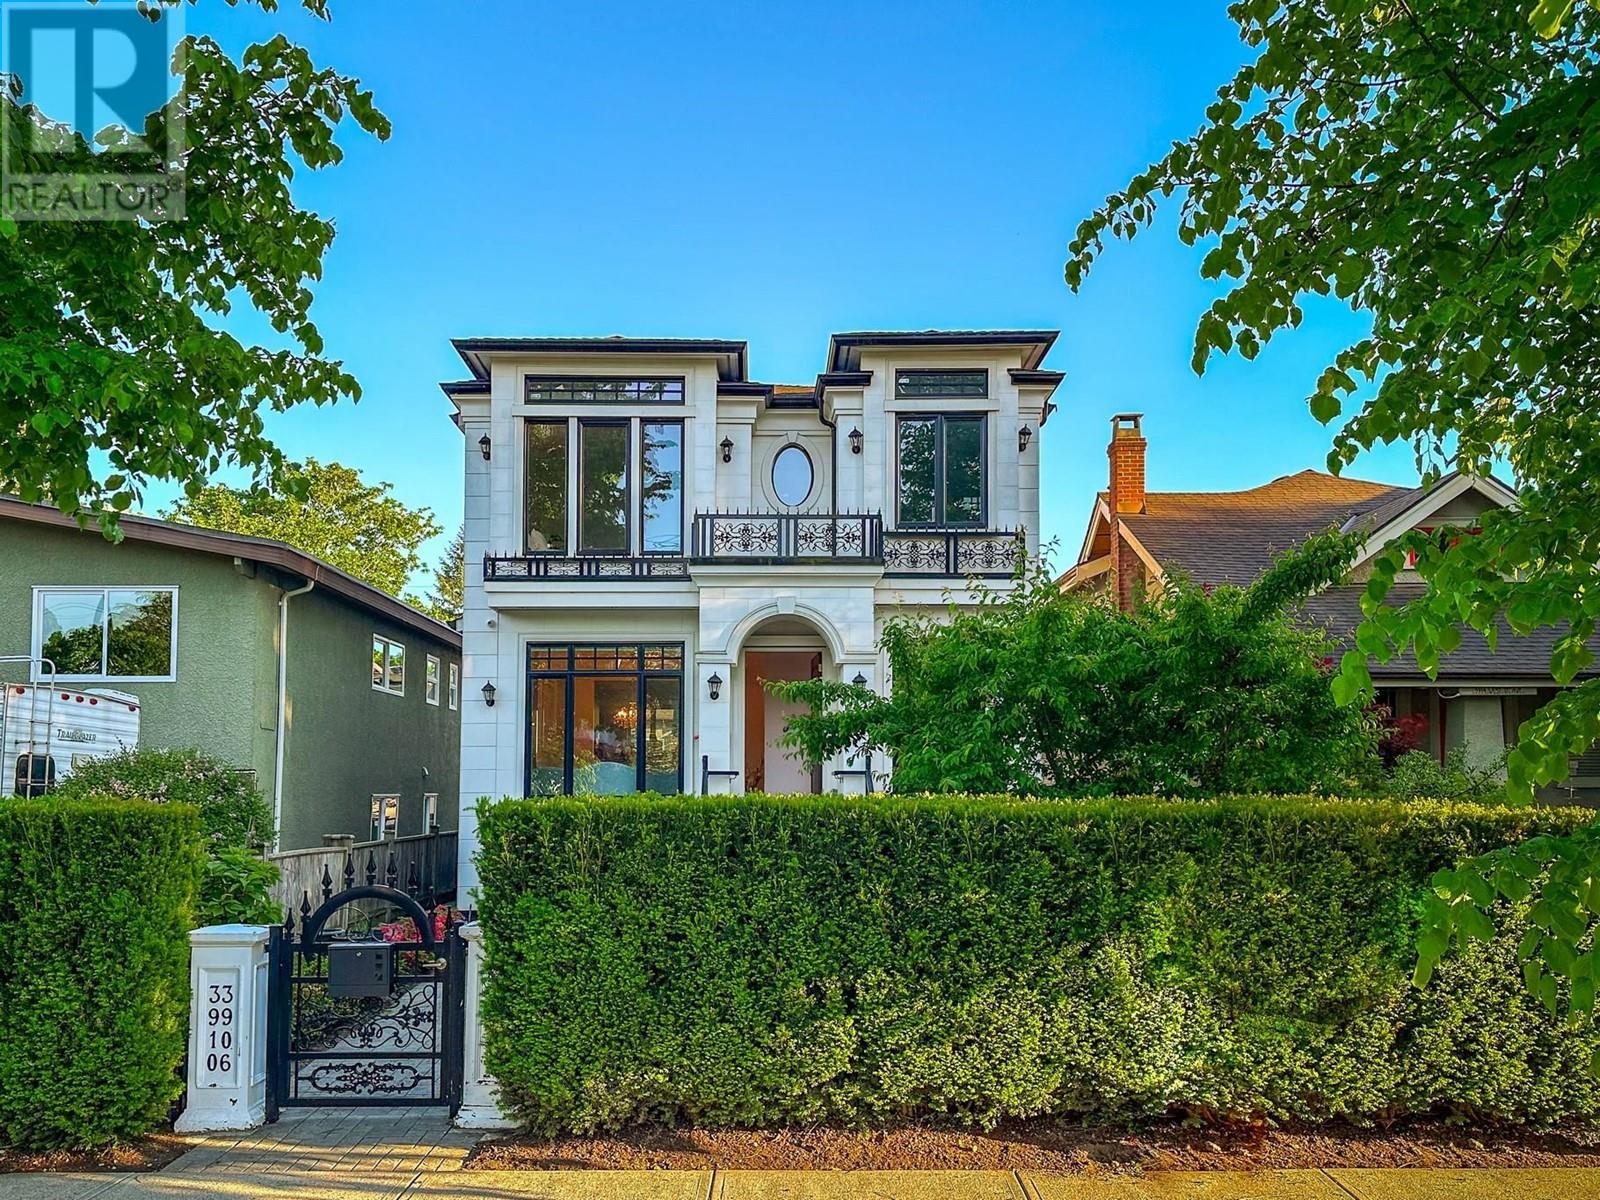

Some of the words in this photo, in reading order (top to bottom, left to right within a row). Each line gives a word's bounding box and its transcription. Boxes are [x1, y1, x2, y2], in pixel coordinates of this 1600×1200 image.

[209, 985, 233, 1004] 33
[208, 1007, 233, 1026] 99
[209, 1030, 232, 1049] 10
[206, 1053, 231, 1072] 06
